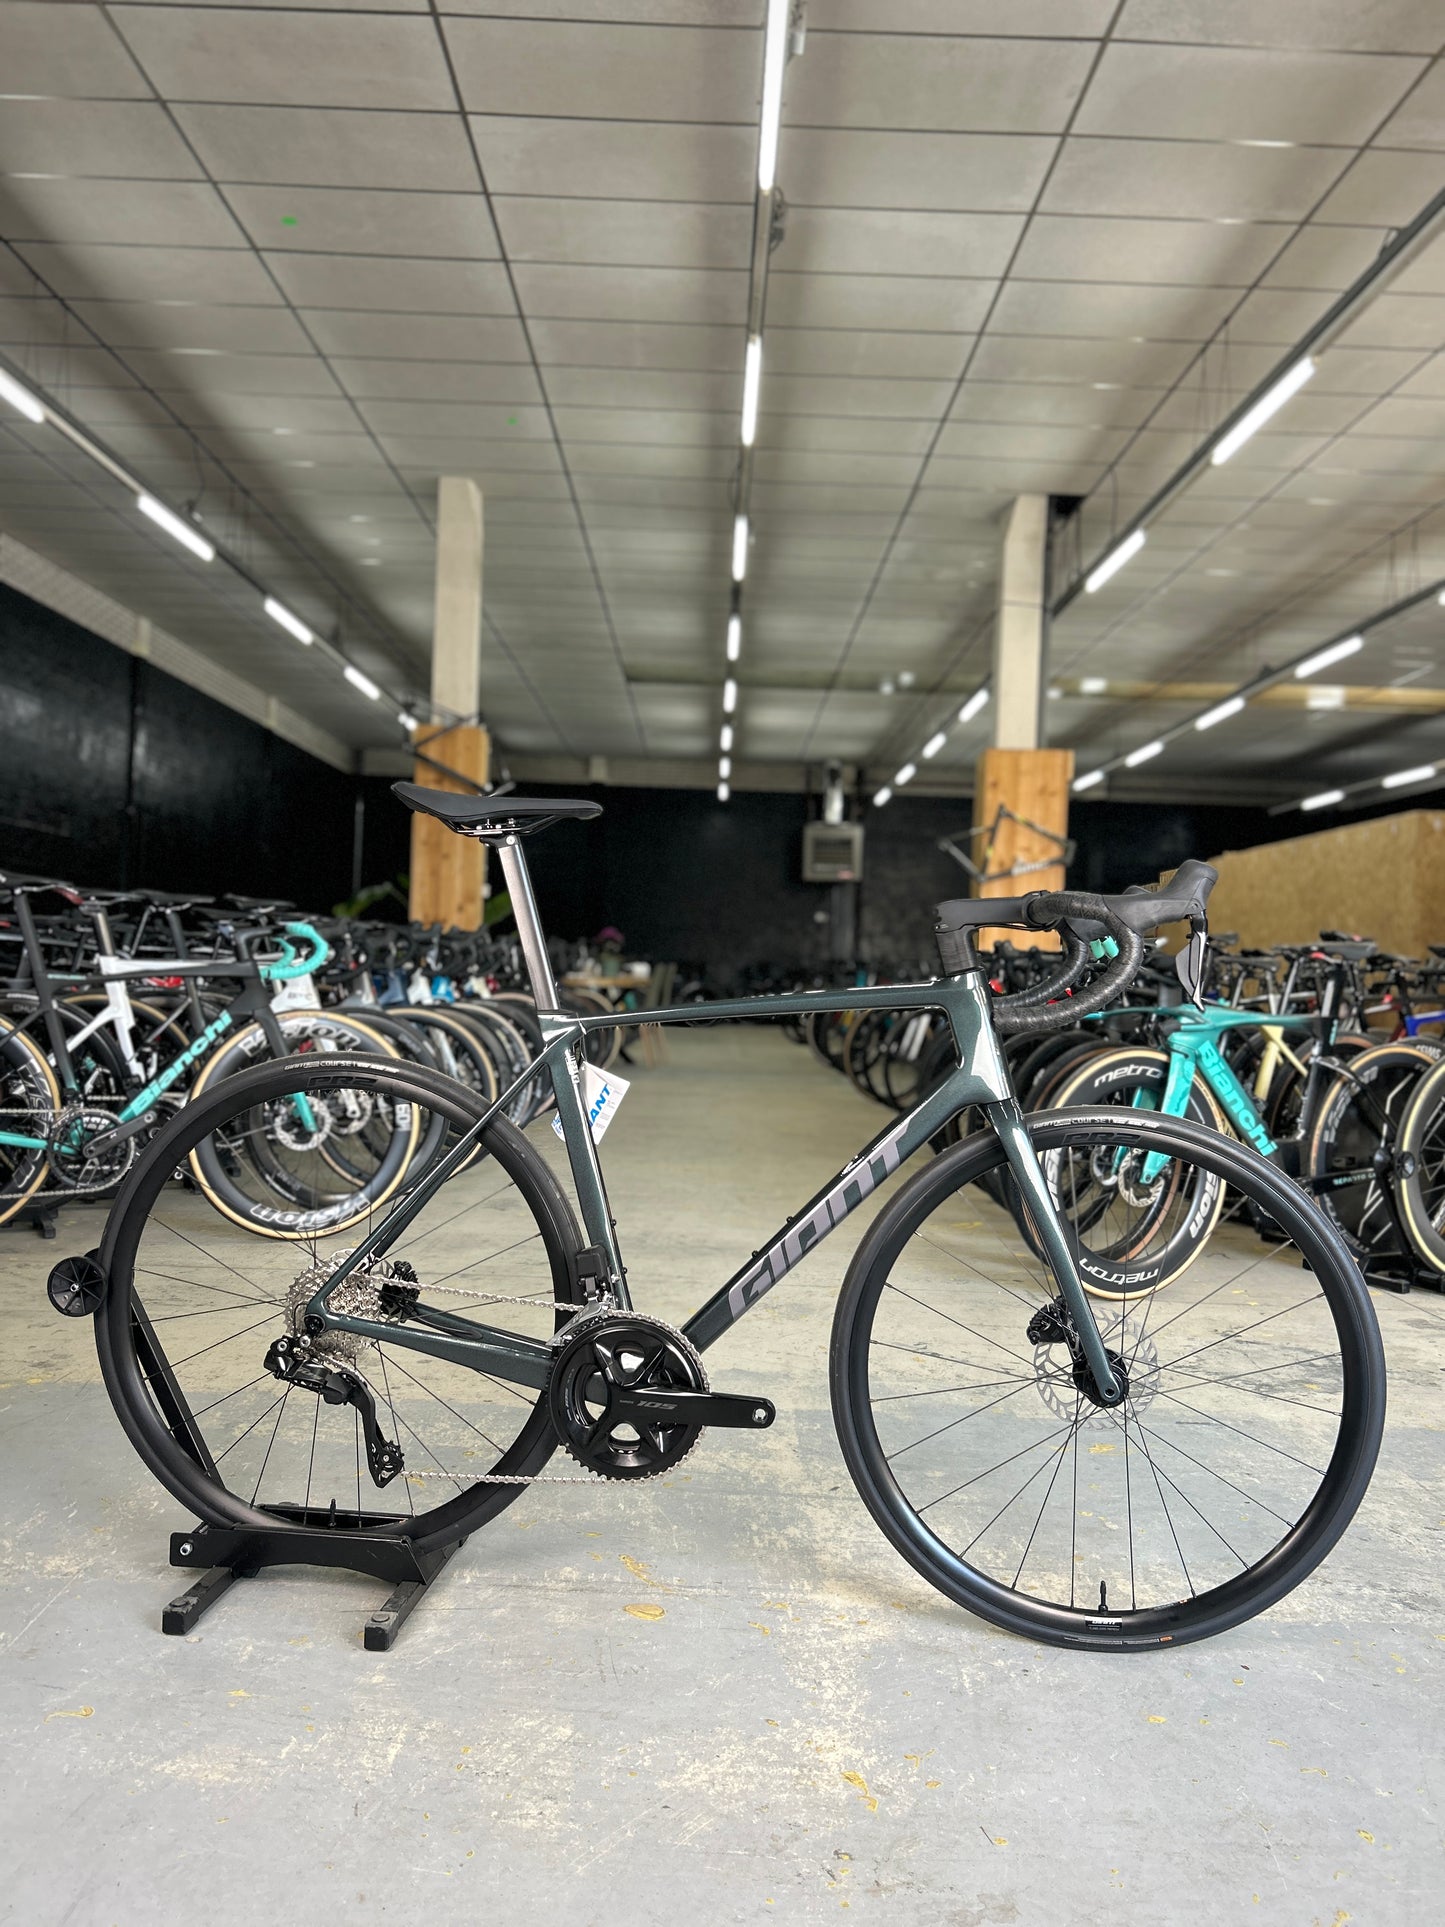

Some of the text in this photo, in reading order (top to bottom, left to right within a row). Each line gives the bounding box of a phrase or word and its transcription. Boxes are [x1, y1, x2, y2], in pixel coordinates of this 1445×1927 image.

[130, 1009, 233, 1116] Bianchi
[307, 1076, 380, 1088] PR2
[1198, 1041, 1279, 1157] Bianchi
[1062, 1132, 1143, 1146] PR2
[1078, 1258, 1160, 1286] metron
[635, 1399, 679, 1411] 105
